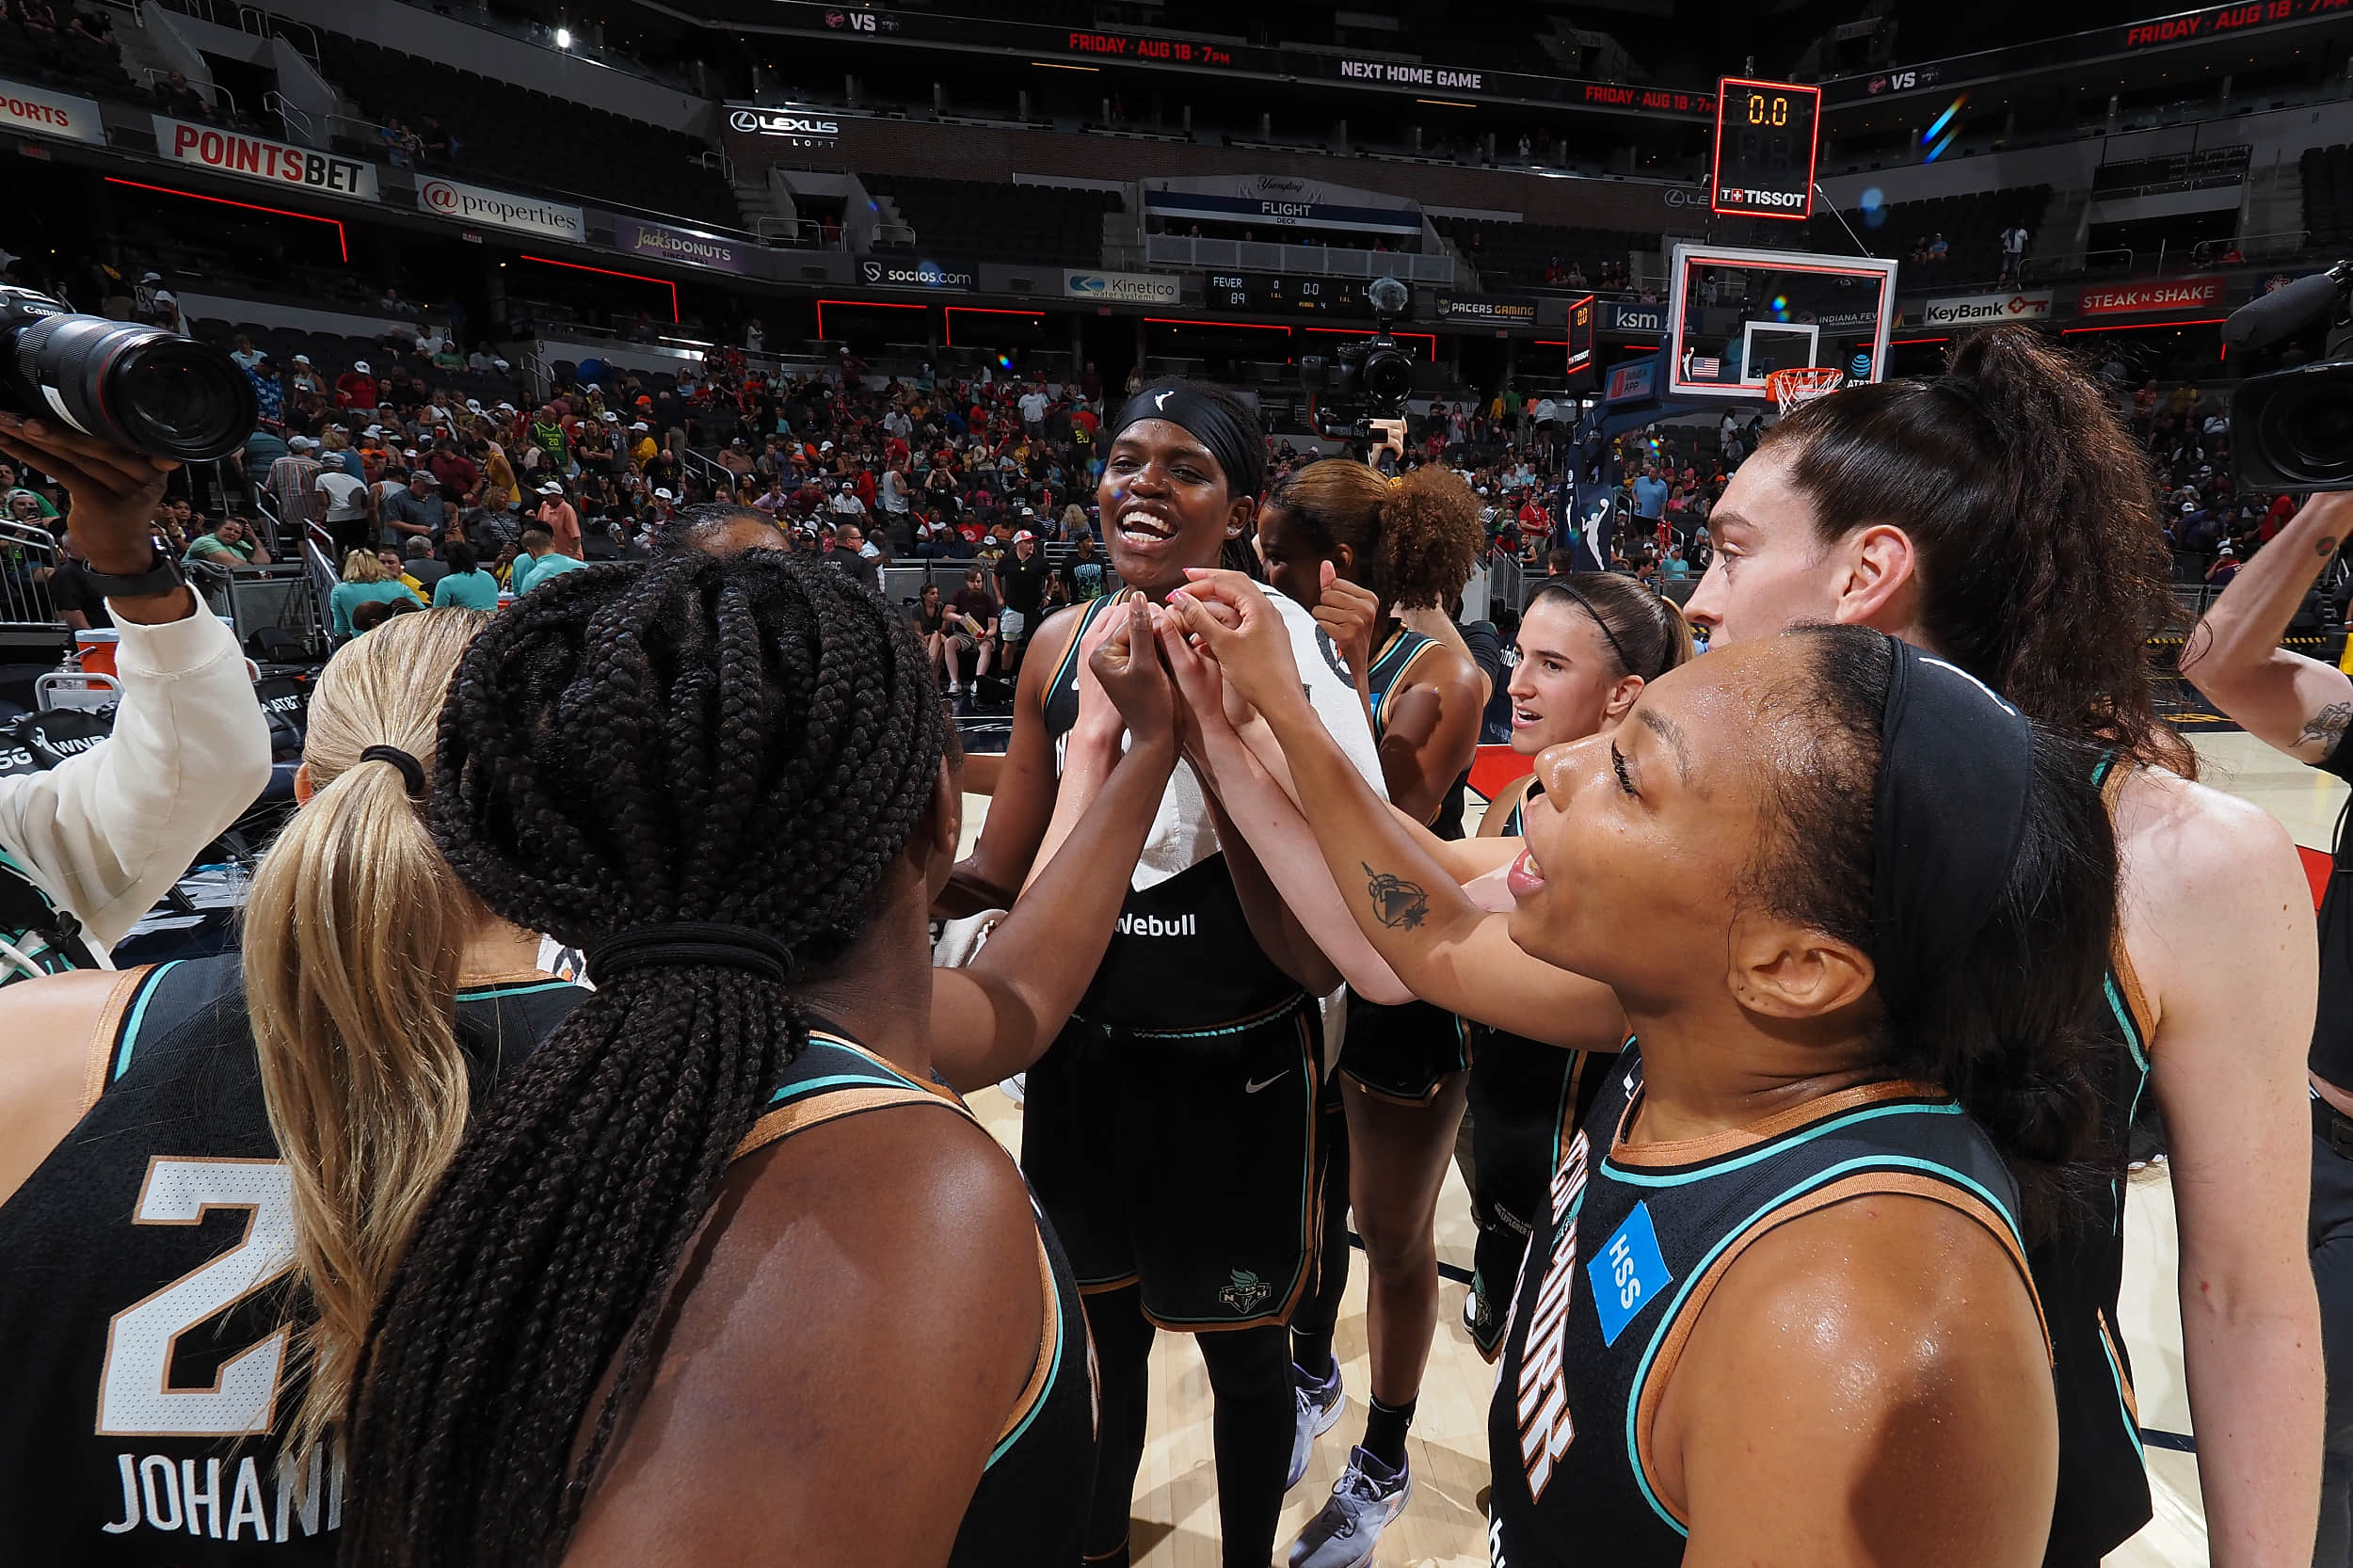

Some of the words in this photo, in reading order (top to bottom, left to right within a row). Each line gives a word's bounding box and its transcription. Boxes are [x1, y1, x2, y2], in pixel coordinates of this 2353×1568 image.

[850, 12, 876, 32] VS
[2127, 17, 2201, 46] FRIDAY
[2216, 4, 2261, 30] AUG
[2267, 0, 2293, 21] 18
[1069, 33, 1127, 54] FRIDAY
[1137, 40, 1171, 58] AUG
[1174, 43, 1191, 60] 18
[1341, 61, 1383, 80] NEXT
[1387, 66, 1433, 85] HOME
[1436, 71, 1481, 89] GAME
[1891, 72, 1916, 90] VS
[1585, 86, 1633, 105] FRIDAY
[1642, 92, 1670, 109] AUG
[1673, 96, 1688, 110] 18
[1749, 95, 1787, 126] 0.0
[759, 115, 839, 135] LEXUS
[792, 138, 835, 149] LOFT
[174, 124, 363, 194] POINTSBET
[1261, 201, 1311, 217] FLIGHT
[1744, 190, 1805, 208] TISSOT
[671, 238, 731, 261] DONUTS
[888, 267, 971, 286] socios.com
[1213, 277, 1242, 289] FEVER
[1112, 279, 1175, 296] Kinetico
[2083, 291, 2137, 309] STEAK
[2141, 293, 2151, 302] N
[2154, 285, 2216, 304] SHAKE
[1230, 292, 1245, 305] 89
[1451, 302, 1493, 314] PACERS
[1494, 304, 1536, 316] GAMING
[1616, 305, 1658, 329] ksm
[1818, 312, 1857, 324] INDIANA
[1858, 312, 1879, 320] FEV
[1927, 302, 2004, 323] KeyBank
[270, 696, 301, 713] AT&T
[1609, 1233, 1641, 1311] HSS
[96, 1156, 344, 1436] 2
[102, 1442, 344, 1544] JOHAN
